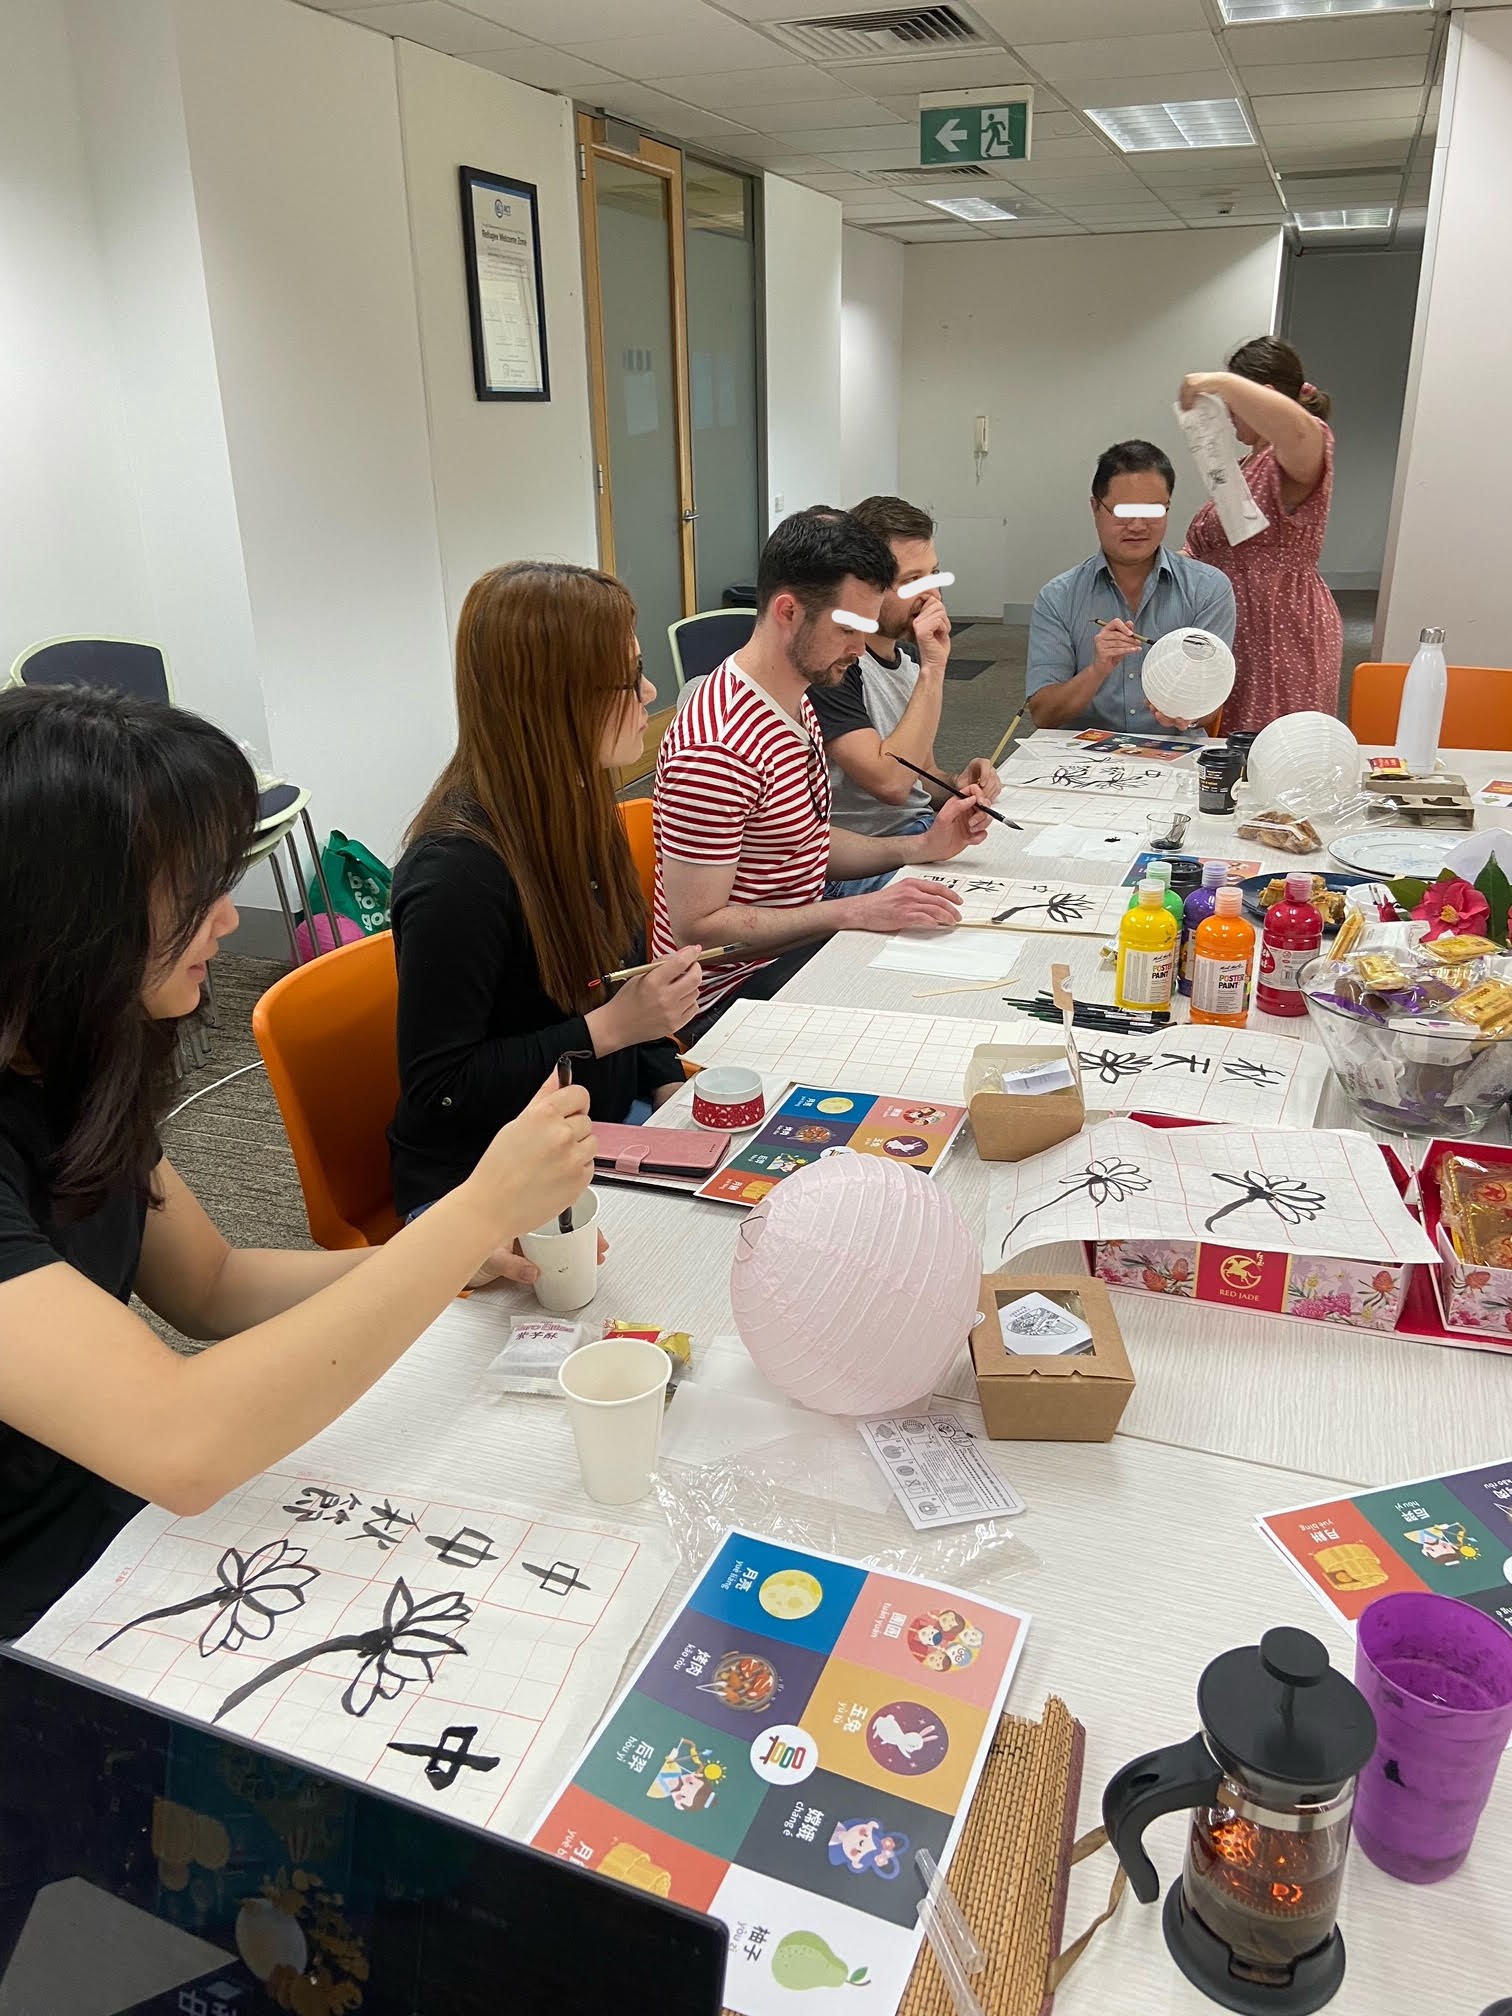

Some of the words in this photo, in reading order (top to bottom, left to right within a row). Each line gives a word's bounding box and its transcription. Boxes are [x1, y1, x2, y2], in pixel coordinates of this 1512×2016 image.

[1151, 971, 1169, 979] PAINT
[1152, 962, 1173, 972] POSTE
[1219, 973, 1245, 982] POSTER
[1218, 981, 1239, 989] PAINT
[1219, 1289, 1237, 1298] RED
[1238, 1292, 1260, 1302] JADE
[1400, 1507, 1430, 1523] 后羿
[735, 1567, 759, 1592] 月亮
[685, 1648, 712, 1676] 烤肉
[843, 1703, 869, 1733] 玉兔
[622, 1735, 638, 1753] hòu
[628, 1740, 655, 1773] 后羿
[386, 1725, 501, 1791] 中
[783, 1801, 804, 1829] cháng
[795, 1807, 825, 1842] 嫦娥
[743, 1925, 771, 1961] 柚子
